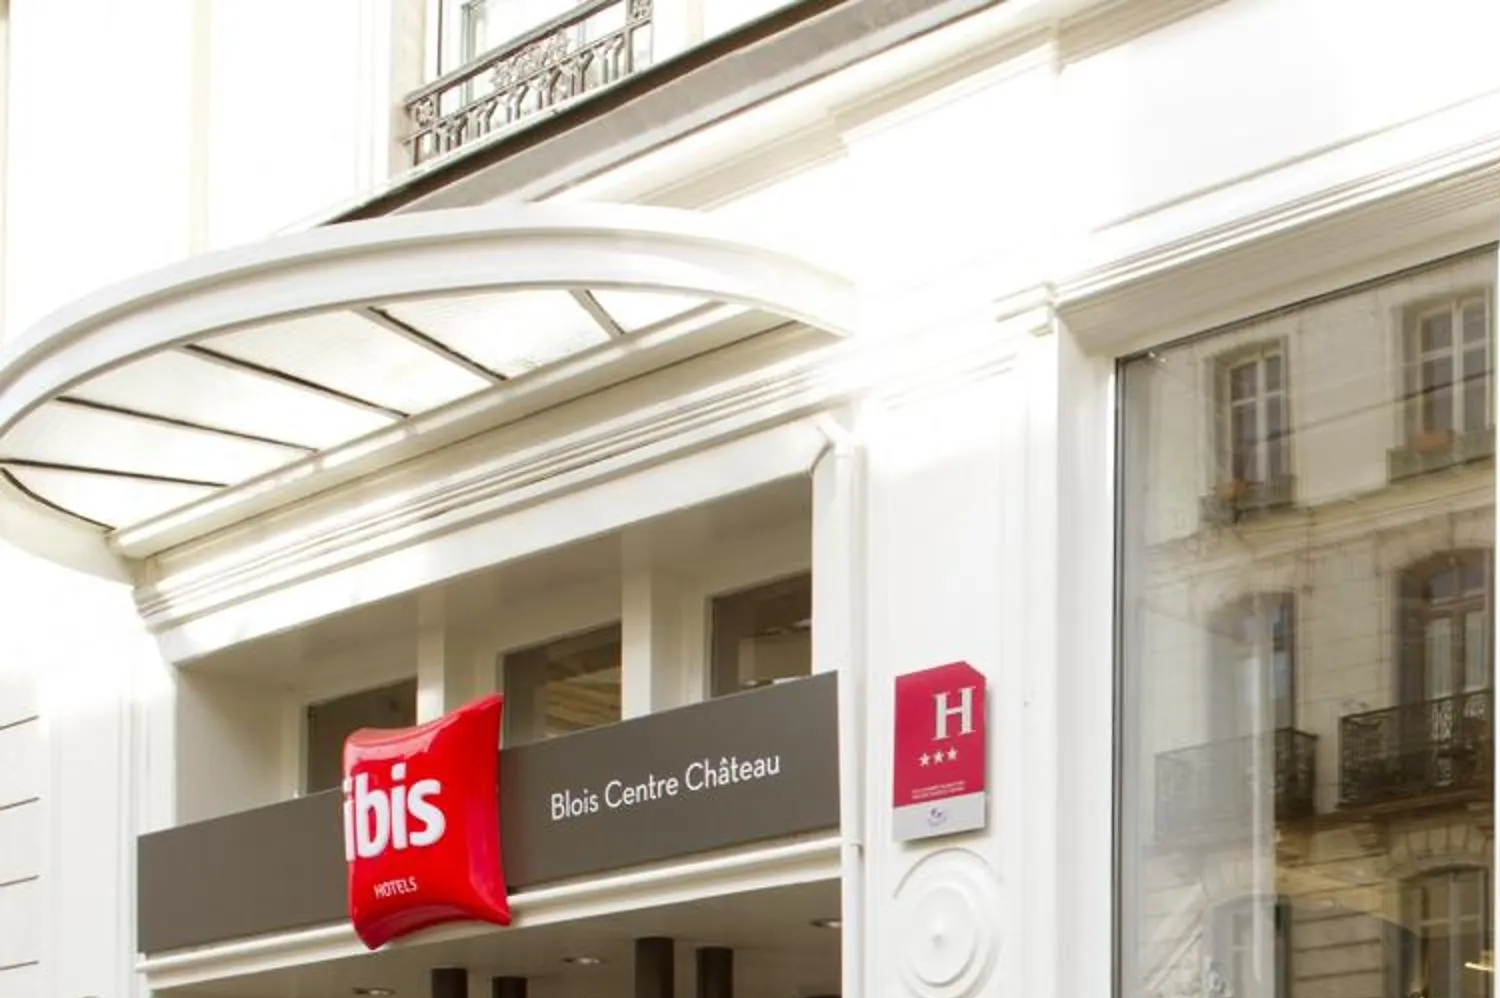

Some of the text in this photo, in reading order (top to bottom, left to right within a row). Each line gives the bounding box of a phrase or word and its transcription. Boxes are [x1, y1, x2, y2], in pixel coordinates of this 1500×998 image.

[931, 686, 977, 741] H
[343, 761, 447, 862] ibis
[550, 754, 781, 821] Blois Centre Château
[373, 875, 418, 899] HOTELS
